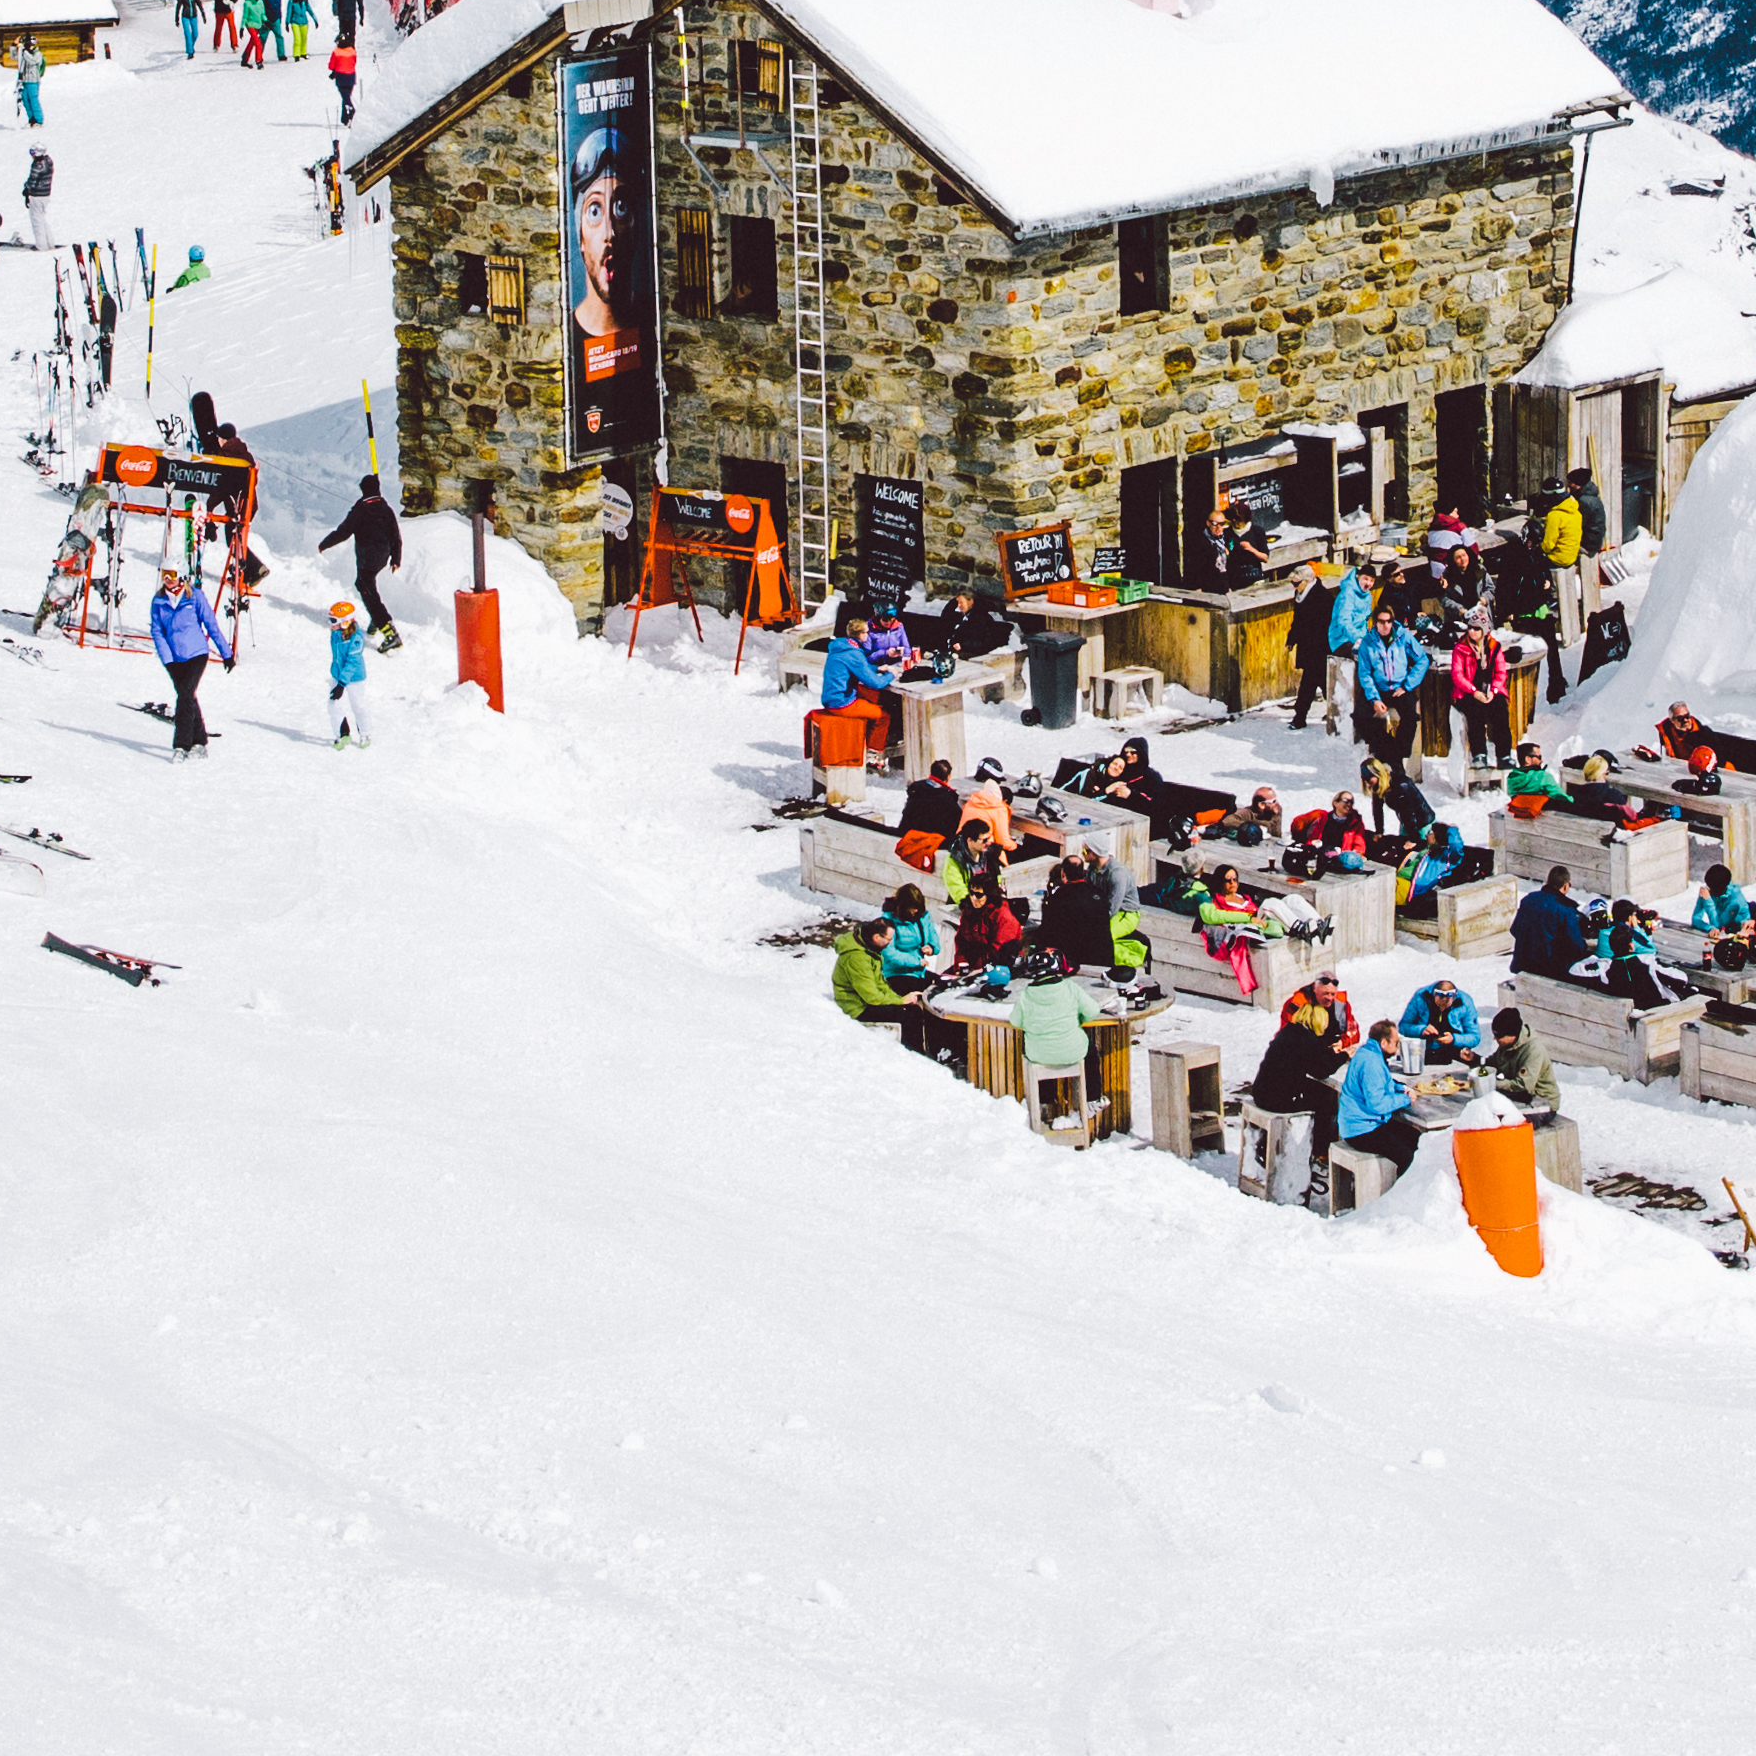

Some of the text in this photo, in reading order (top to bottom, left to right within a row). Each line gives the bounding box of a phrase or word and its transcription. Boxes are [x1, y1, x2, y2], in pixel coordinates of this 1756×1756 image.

[592, 76, 635, 97] WAHNSINN
[577, 91, 633, 115] GEHT WEITER!
[120, 458, 153, 473] Coca-Cola
[874, 481, 919, 510] WELCOME
[728, 507, 751, 520] Coca-Cola
[1017, 534, 1053, 555] RETOUR
